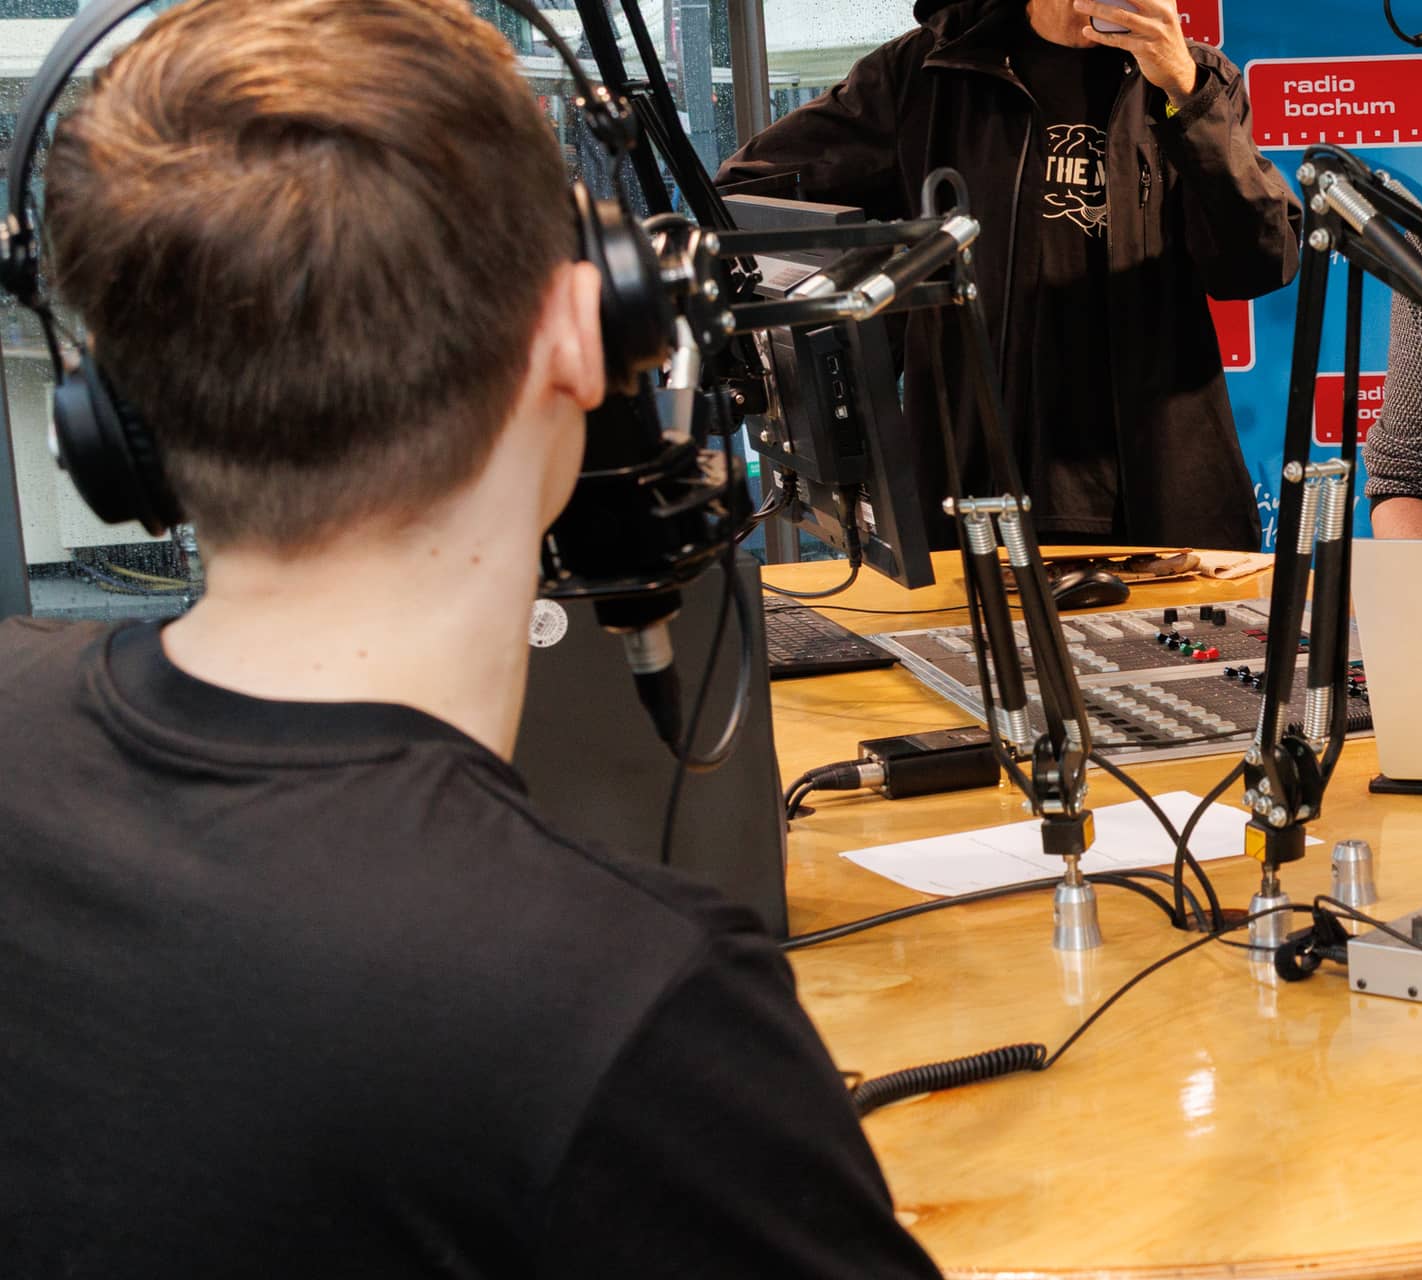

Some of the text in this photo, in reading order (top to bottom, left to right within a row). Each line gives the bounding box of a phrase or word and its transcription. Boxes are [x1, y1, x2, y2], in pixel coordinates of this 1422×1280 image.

[1283, 75, 1355, 94] radio
[1284, 98, 1396, 117] bochum
[1045, 156, 1089, 185] THE
